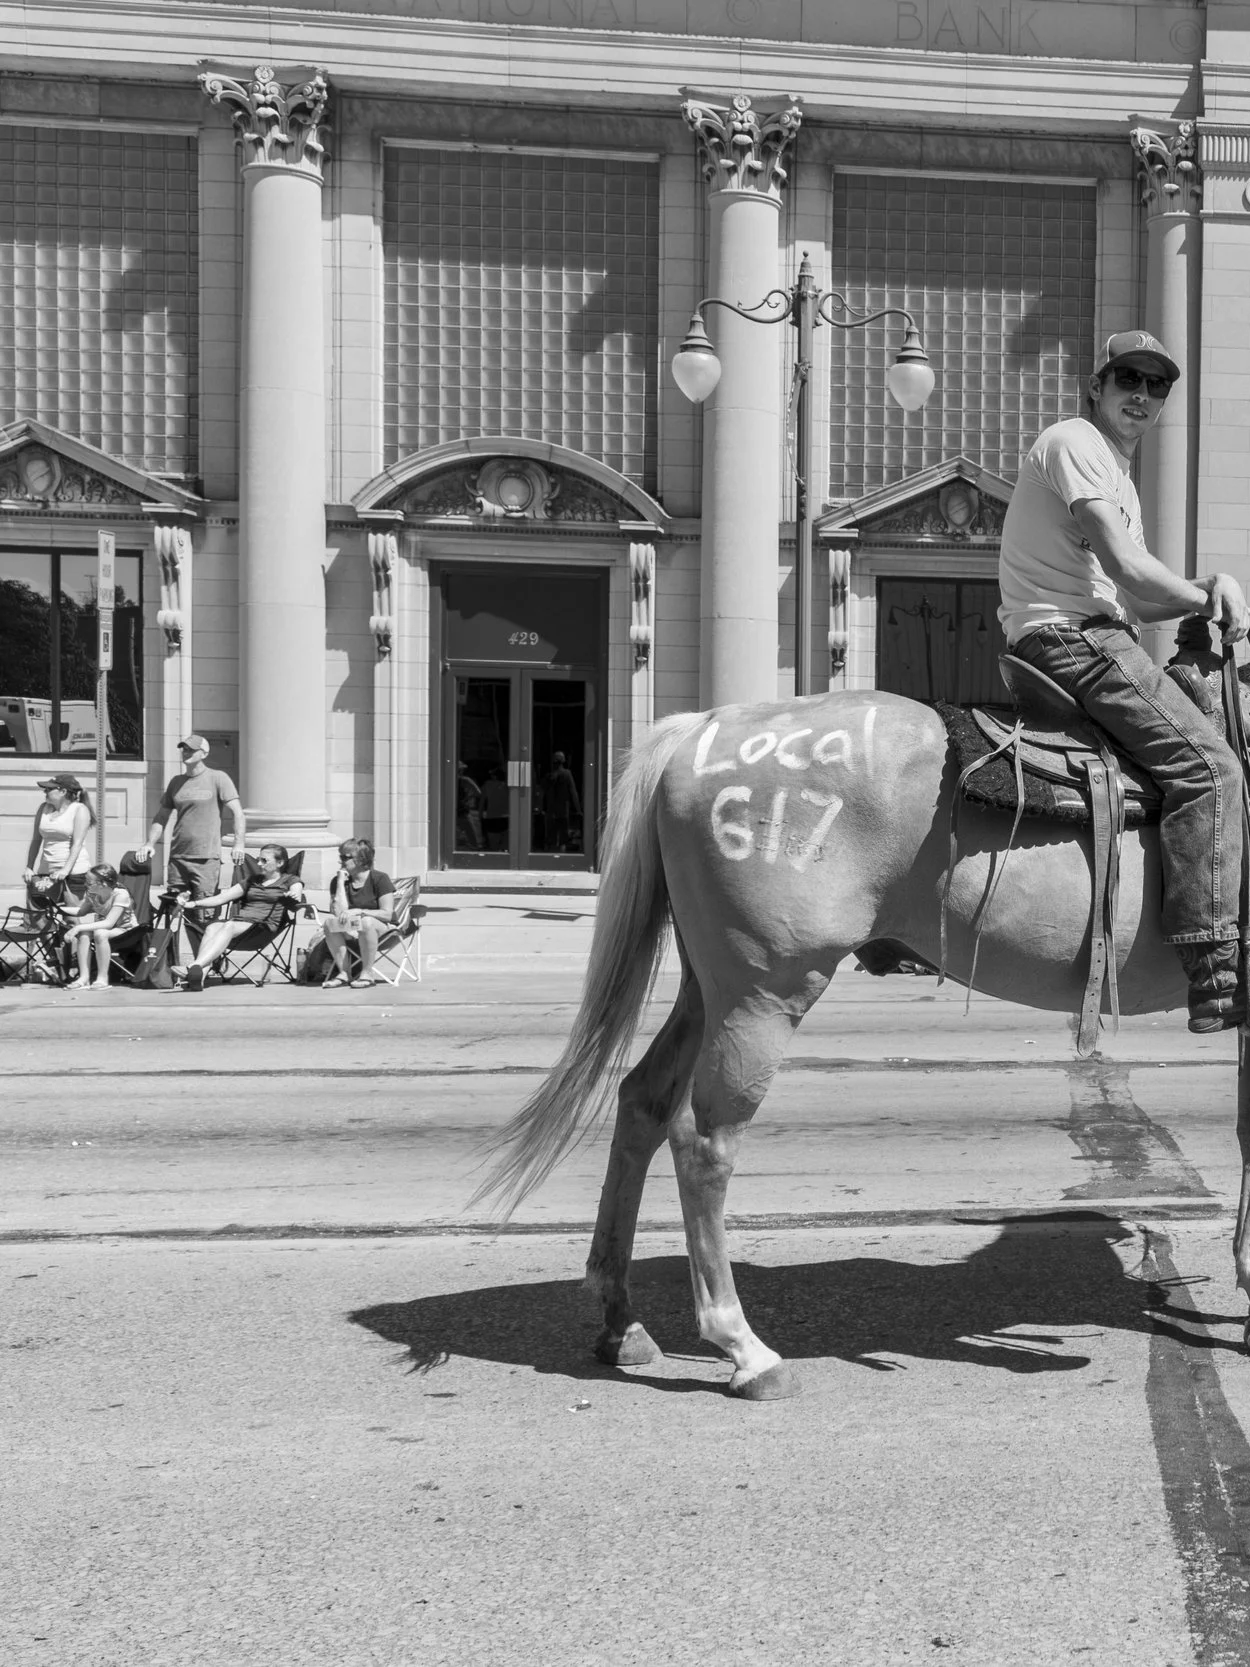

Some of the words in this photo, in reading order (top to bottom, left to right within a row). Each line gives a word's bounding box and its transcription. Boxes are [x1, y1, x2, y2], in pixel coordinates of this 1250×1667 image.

[364, 0, 661, 25] ONAL
[893, 0, 1045, 50] BANK
[507, 631, 540, 646] 429
[692, 706, 877, 780] Local
[711, 785, 844, 873] 617
